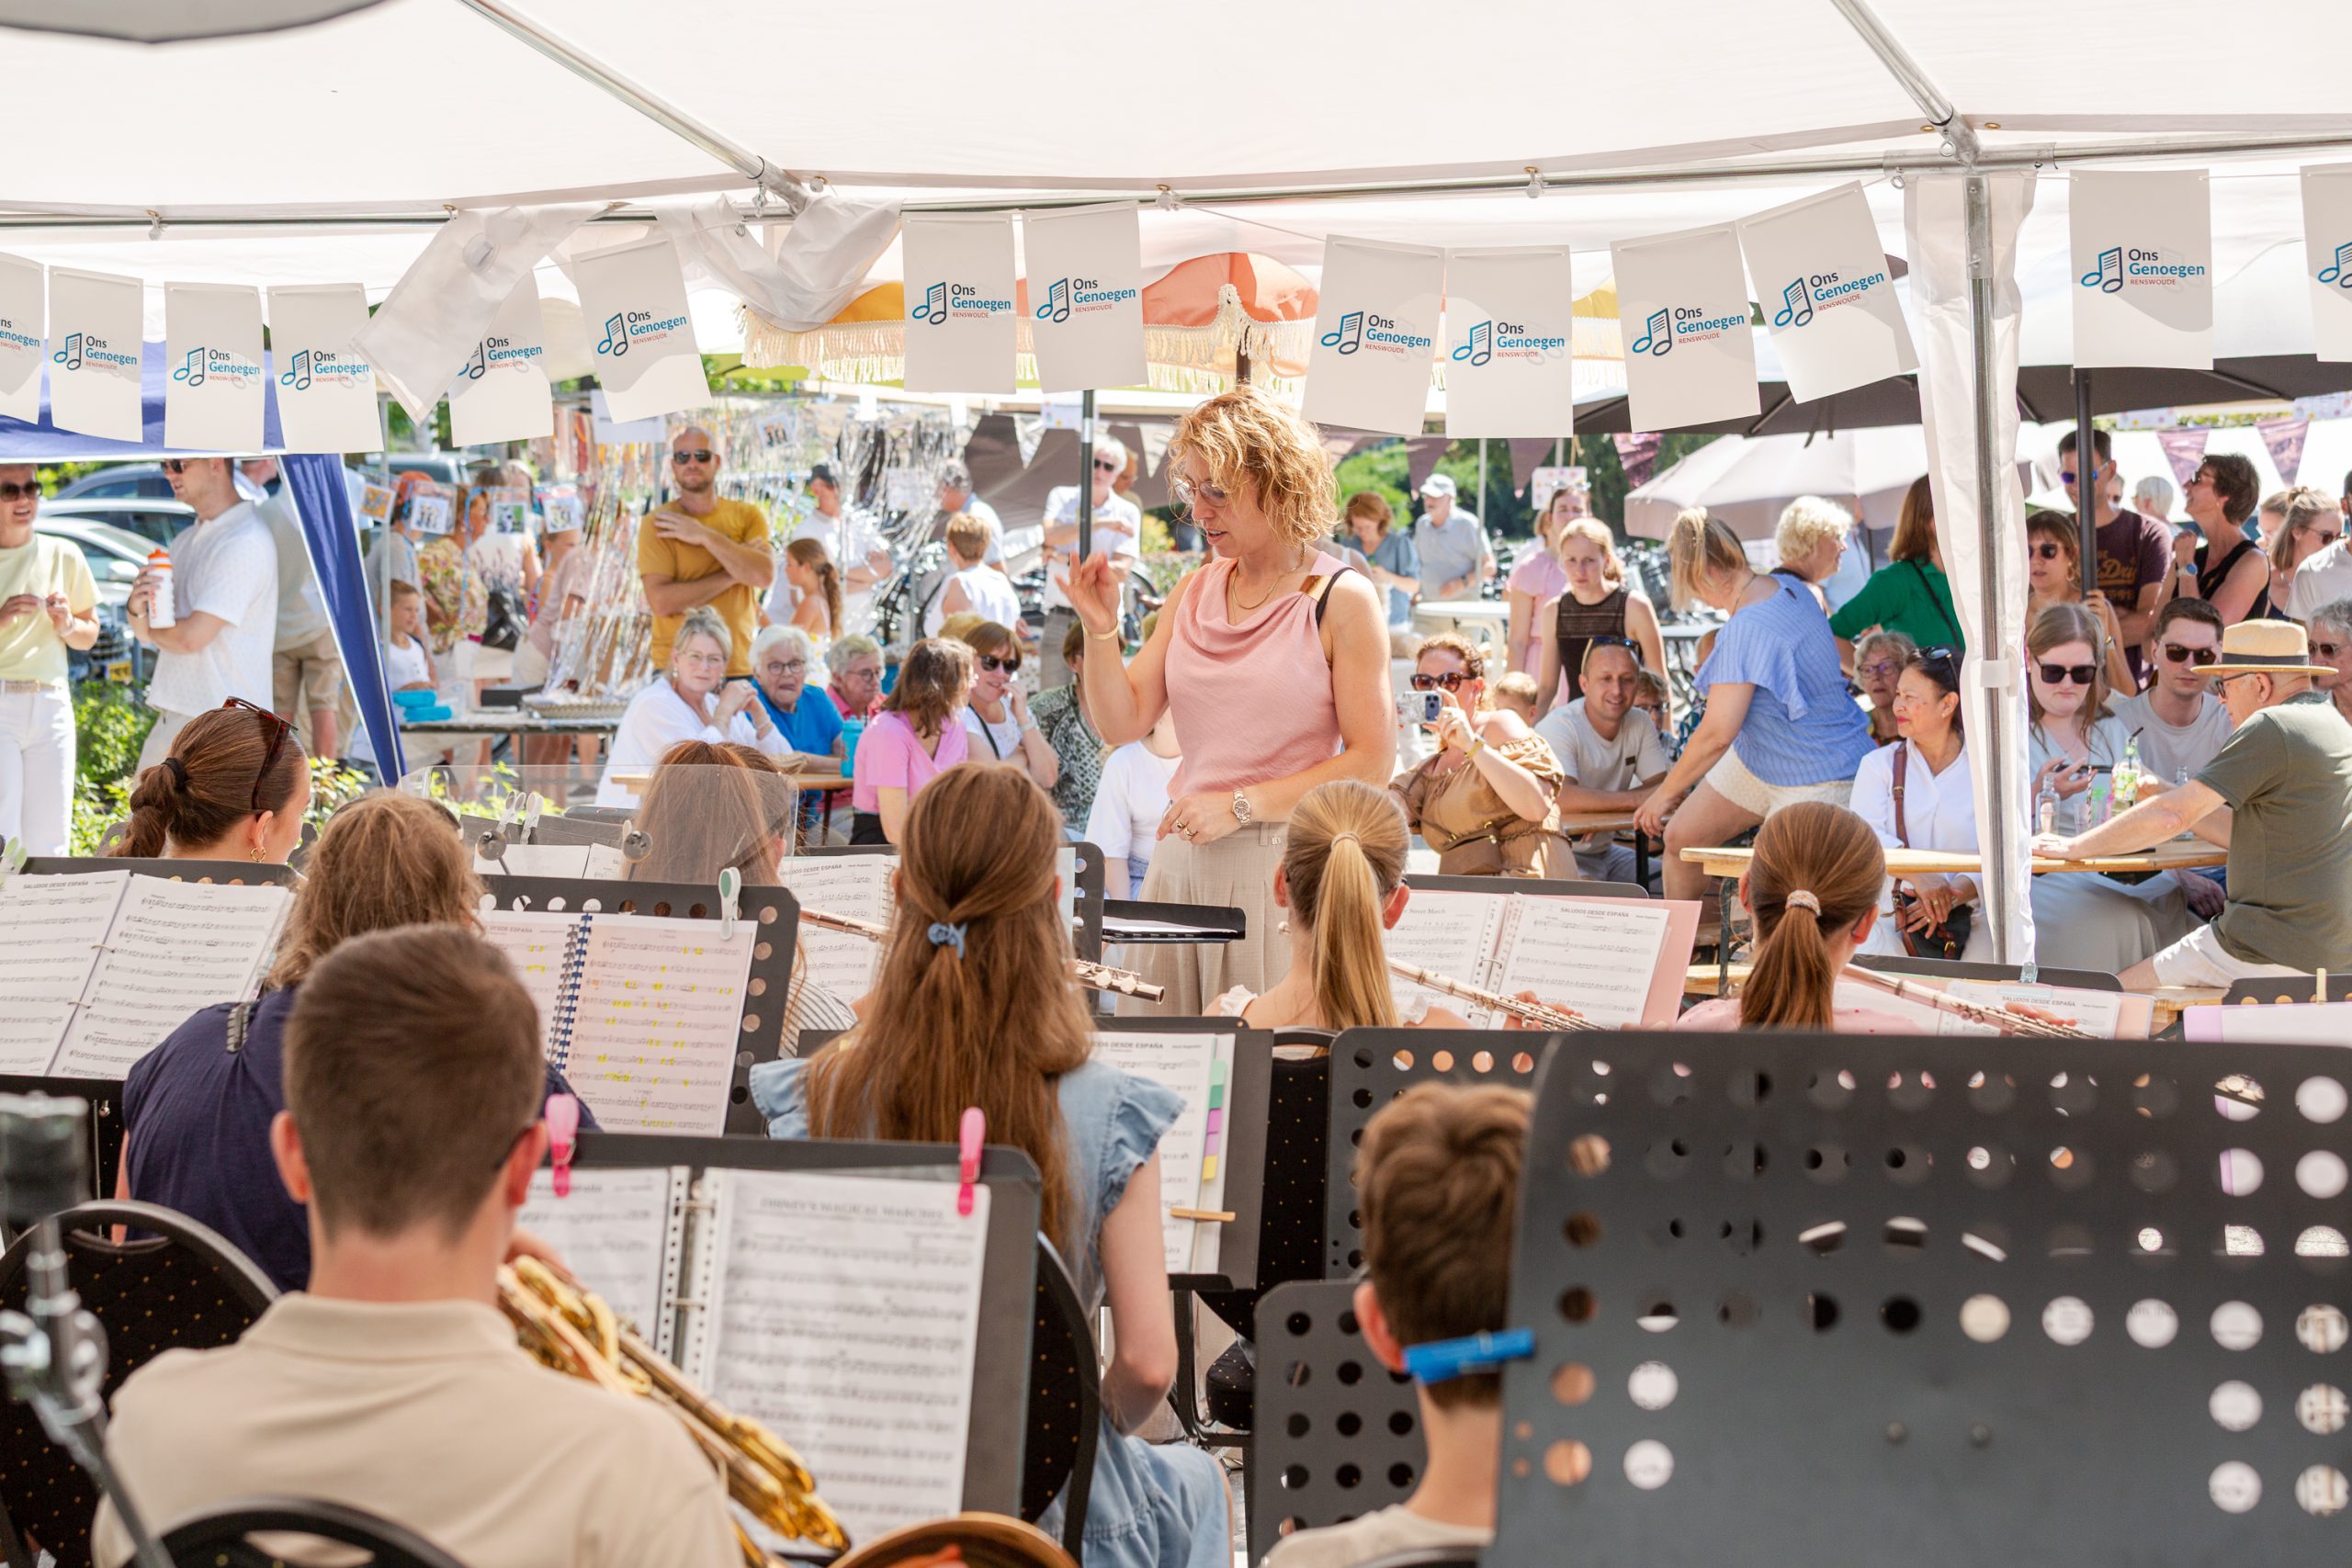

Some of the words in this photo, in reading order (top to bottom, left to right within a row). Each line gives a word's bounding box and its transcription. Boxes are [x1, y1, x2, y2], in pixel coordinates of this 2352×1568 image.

[2129, 249, 2158, 261] Ons
[2129, 263, 2204, 277] Genoegen
[1073, 278, 1098, 290] Ons
[1810, 272, 1838, 288] Ons
[1814, 271, 1884, 301] Genoegen
[952, 284, 976, 296] Ons
[1074, 288, 1136, 303] Genoegen
[952, 297, 1011, 311] Genoegen
[1075, 304, 1113, 312] RENSWOUDE
[1818, 294, 1860, 310] RENSWOUDE
[628, 310, 650, 324] Ons
[1675, 308, 1702, 321] Ons
[0, 318, 12, 329] ns
[629, 314, 687, 335] Genoegen
[1368, 315, 1394, 329] Ons
[1498, 322, 1523, 334] Ons
[1677, 314, 1744, 334] Genoegen
[0, 328, 40, 348] enoegen
[86, 336, 107, 349] Ons
[487, 337, 509, 348] Ons
[632, 333, 667, 345] RENSWOUDE
[1367, 328, 1430, 347] Genoegen
[1498, 335, 1565, 349] Genoegen
[1679, 333, 1720, 344] RENSWOUDE
[0, 342, 21, 351] SWOUDE
[488, 344, 542, 361] Genoegen
[1365, 344, 1404, 353] RENSWOUDE
[86, 347, 137, 366] Genoegen
[209, 349, 231, 361] Ons
[314, 351, 336, 362] Ons
[209, 362, 260, 376] Genoegen
[314, 363, 369, 376] Genoegen
